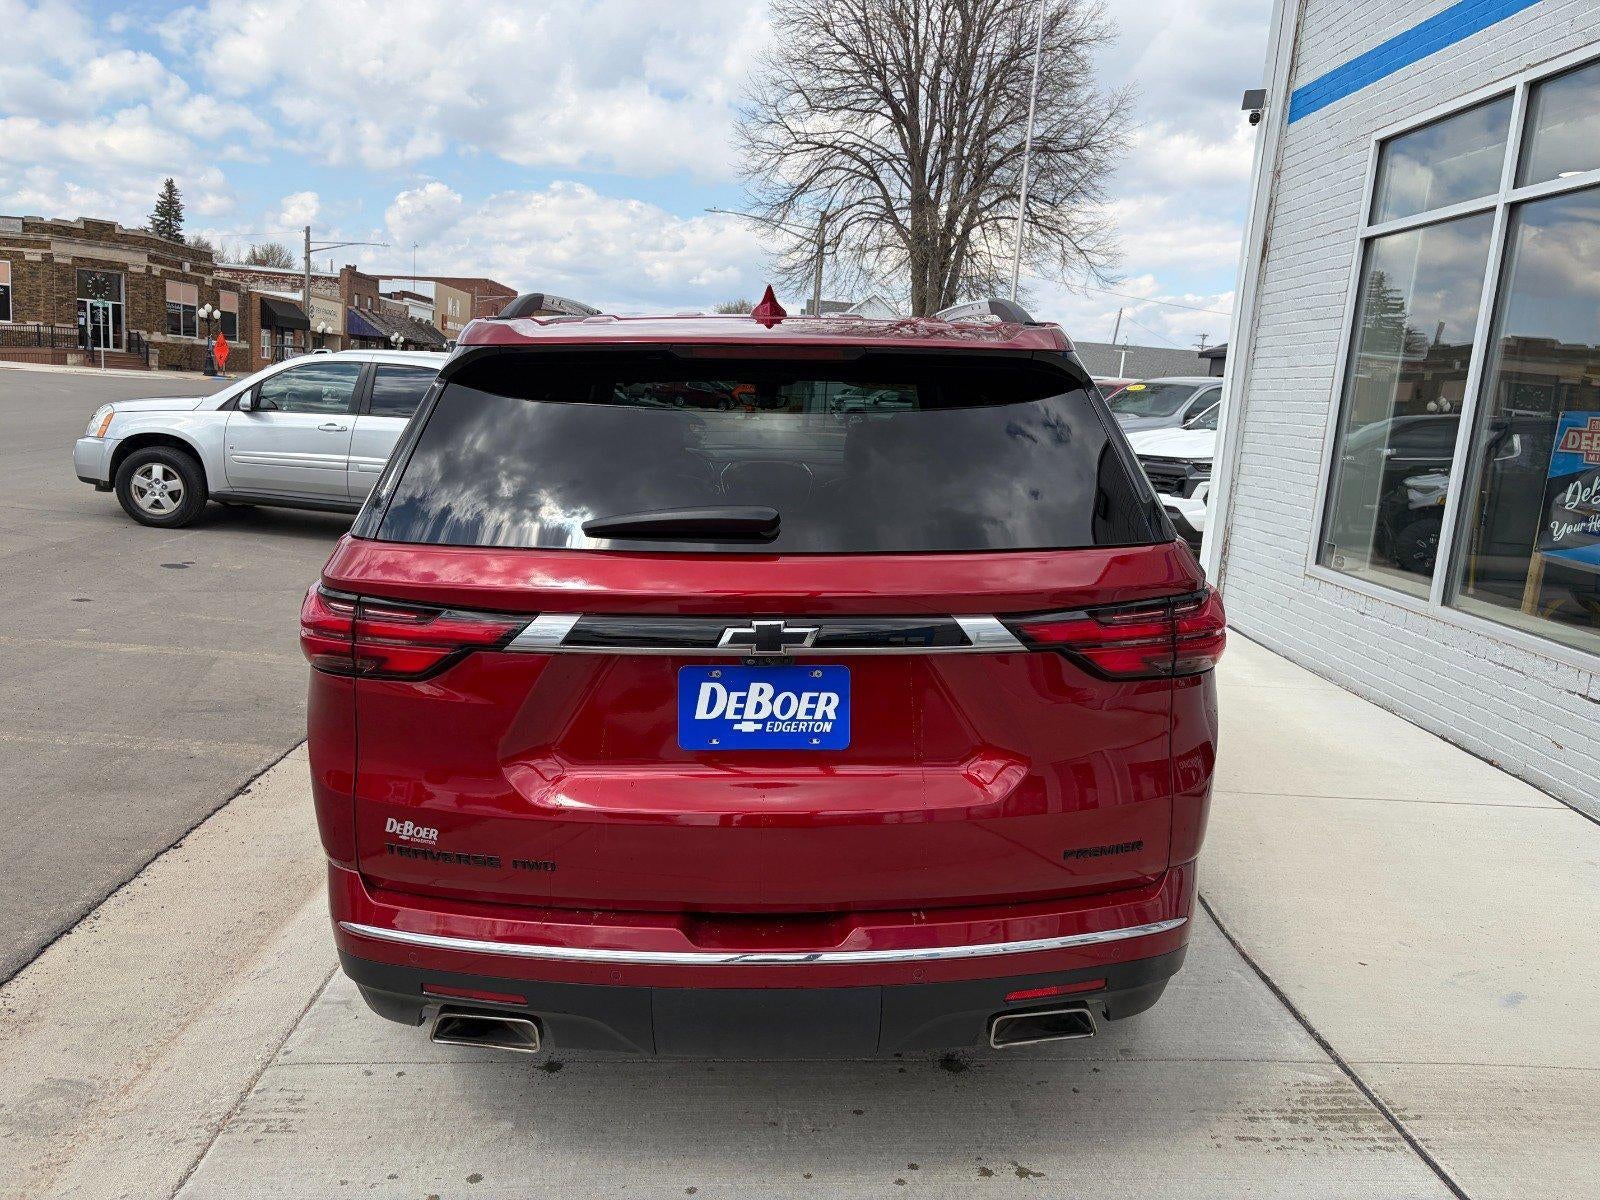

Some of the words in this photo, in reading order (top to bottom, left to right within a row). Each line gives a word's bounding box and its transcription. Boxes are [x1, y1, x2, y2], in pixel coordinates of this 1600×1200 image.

[1550, 520, 1586, 542] Your
[765, 721, 832, 733] EDGERTON
[385, 843, 501, 868] TRAVERSE
[513, 859, 556, 871] AWD
[1063, 840, 1144, 860] PREMIER
